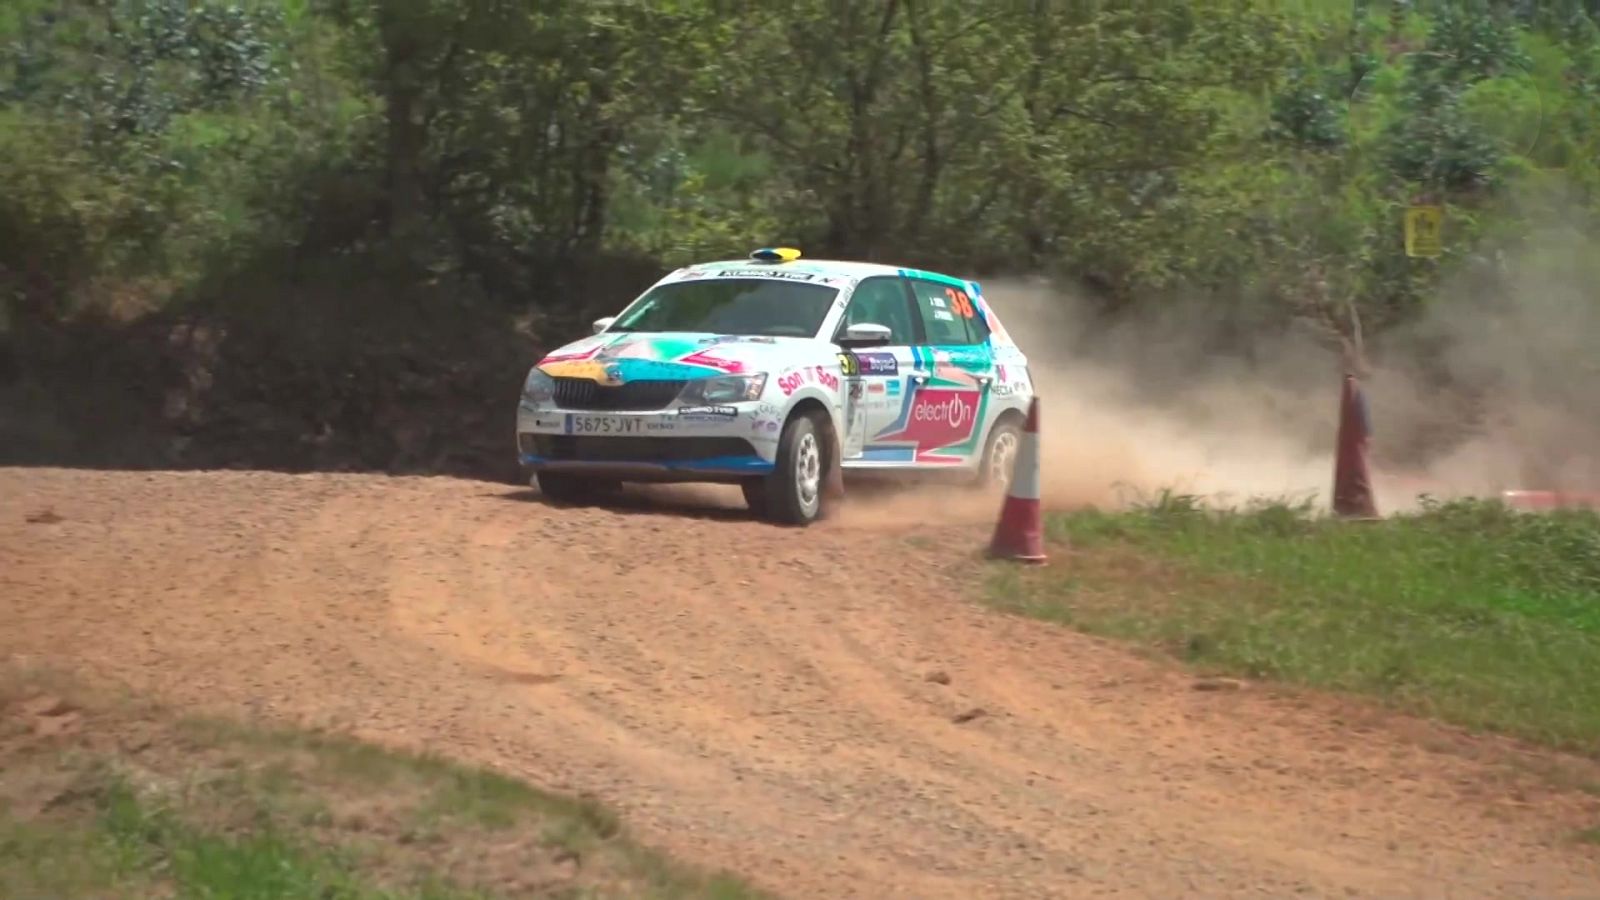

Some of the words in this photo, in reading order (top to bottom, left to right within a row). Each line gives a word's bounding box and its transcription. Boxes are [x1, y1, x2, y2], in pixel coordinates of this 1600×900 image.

[945, 287, 974, 318] 38
[778, 372, 805, 396] Son
[815, 364, 839, 392] Son
[575, 416, 611, 433] 5675
[615, 416, 643, 433] JVT
